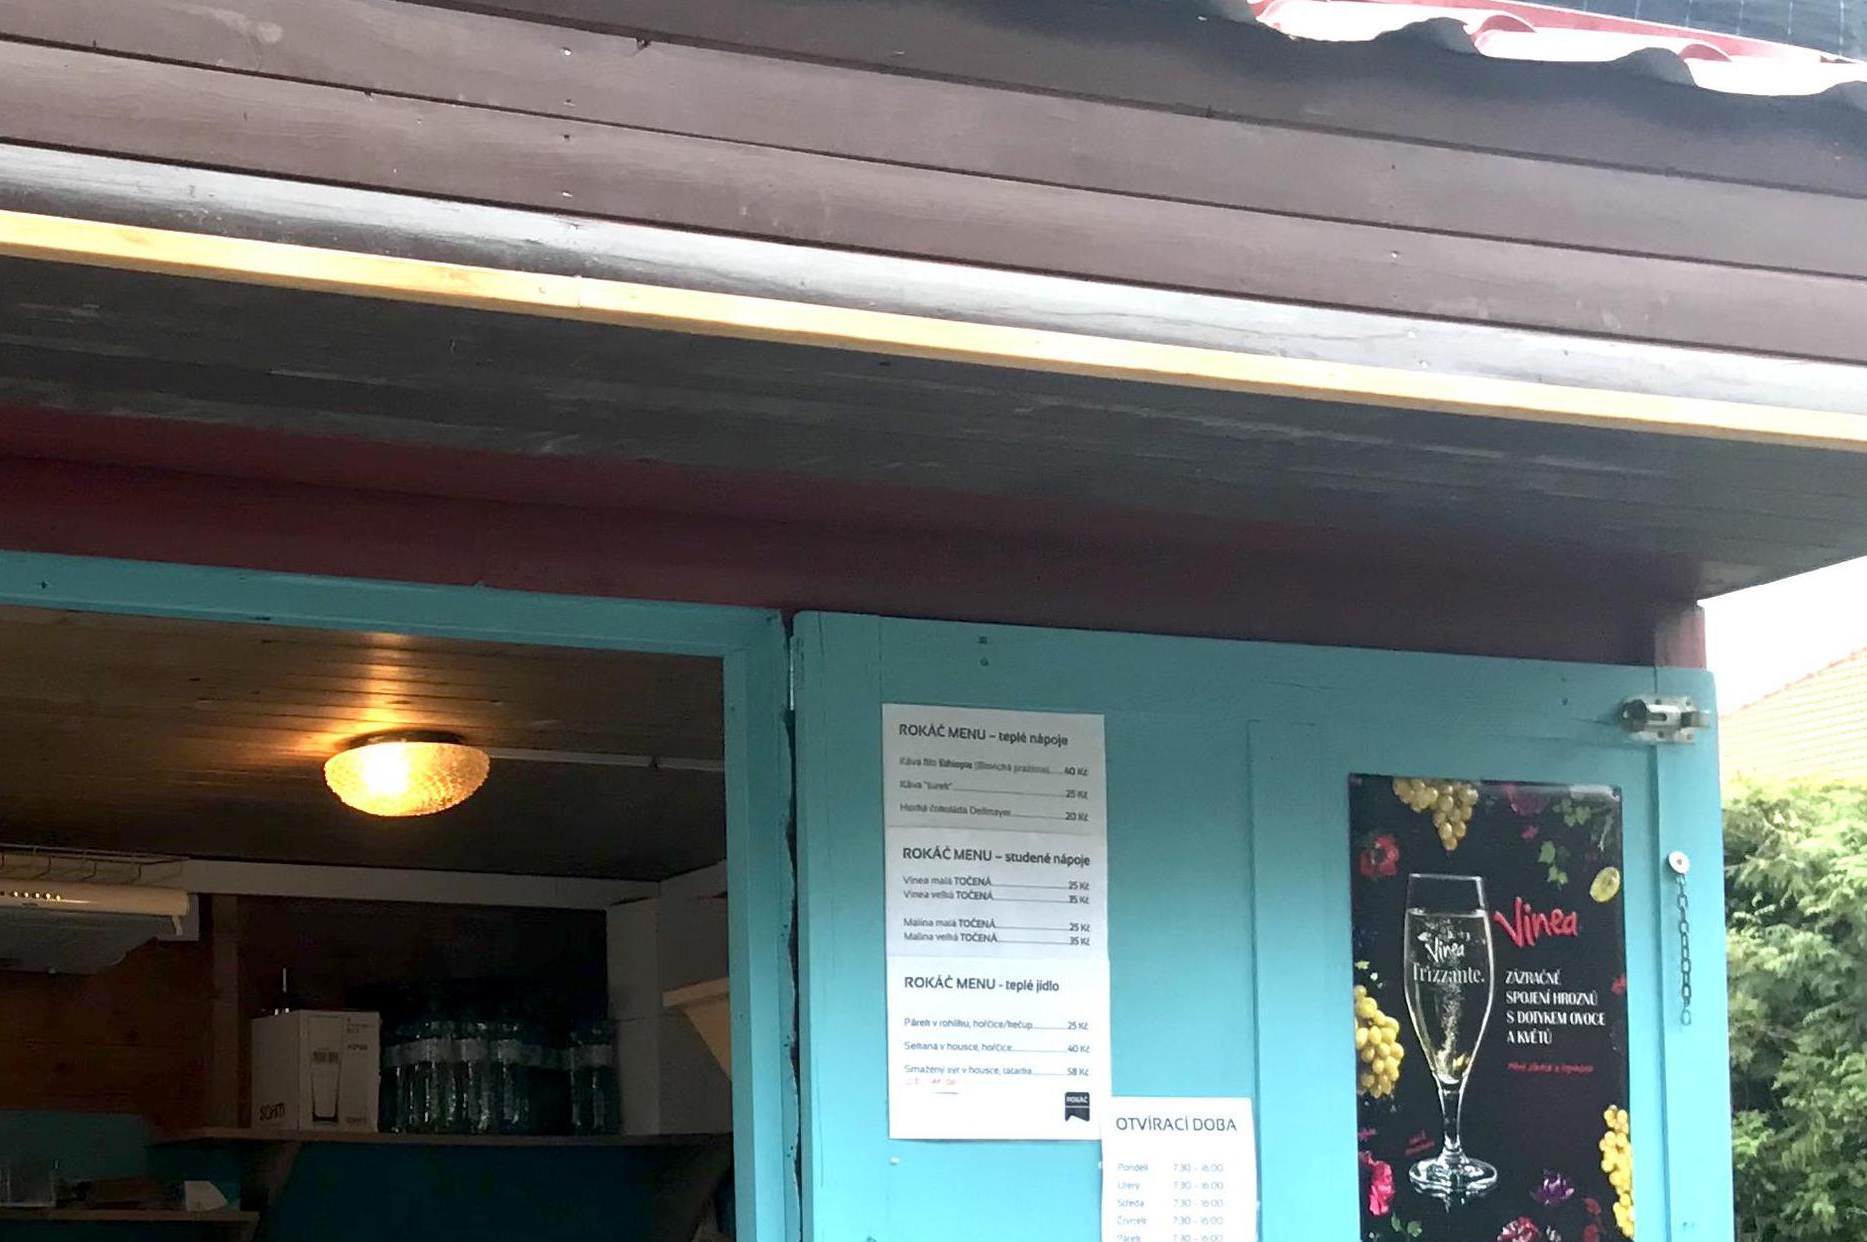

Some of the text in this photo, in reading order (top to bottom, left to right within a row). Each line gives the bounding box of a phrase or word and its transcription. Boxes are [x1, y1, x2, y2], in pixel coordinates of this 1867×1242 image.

[899, 722, 945, 738] ROKÁČ
[947, 727, 987, 741] MENU
[999, 731, 1027, 744] teplé
[1029, 733, 1069, 748] nápoje
[1077, 767, 1089, 777] Kč
[899, 780, 922, 790] Káva
[1065, 790, 1076, 799] 25
[1077, 790, 1089, 800] Kč
[1078, 812, 1089, 822] Kč
[902, 846, 951, 860] ROKÁČ
[954, 849, 992, 862] MENU
[1005, 851, 1051, 865] studené
[1053, 854, 1091, 868] nápoje
[902, 875, 929, 885] Vinea
[954, 874, 992, 887] TOČENÁ
[1080, 881, 1090, 891] Kč
[903, 890, 930, 900] Vinea
[956, 889, 993, 901] TOČENÁ
[1080, 895, 1090, 905] Kč
[903, 917, 934, 928] Malina
[958, 917, 996, 929] TOČENÁ
[1080, 923, 1090, 933] Kč
[1493, 897, 1578, 949] Vinea
[904, 931, 934, 942] Malina
[960, 931, 998, 943] TOČENÁ
[1080, 937, 1090, 947] Kč
[1425, 937, 1465, 963] Vinea
[904, 974, 953, 989] ROKÁČ
[956, 977, 996, 990] MENU
[1006, 979, 1033, 993] teplé
[1036, 978, 1060, 993] jídlo
[1506, 989, 1551, 1006] SPOJENÍ
[1067, 1021, 1078, 1030] 25
[1079, 1021, 1089, 1030] Kč
[1506, 1011, 1606, 1026] S DOTYKEM OVOCE
[1506, 1030, 1515, 1044] A
[1067, 1044, 1078, 1053] 40
[1080, 1044, 1090, 1053] Kč
[1079, 1067, 1089, 1076] Kč
[1116, 1116, 1237, 1132] OTVÍRACÍ DOBA
